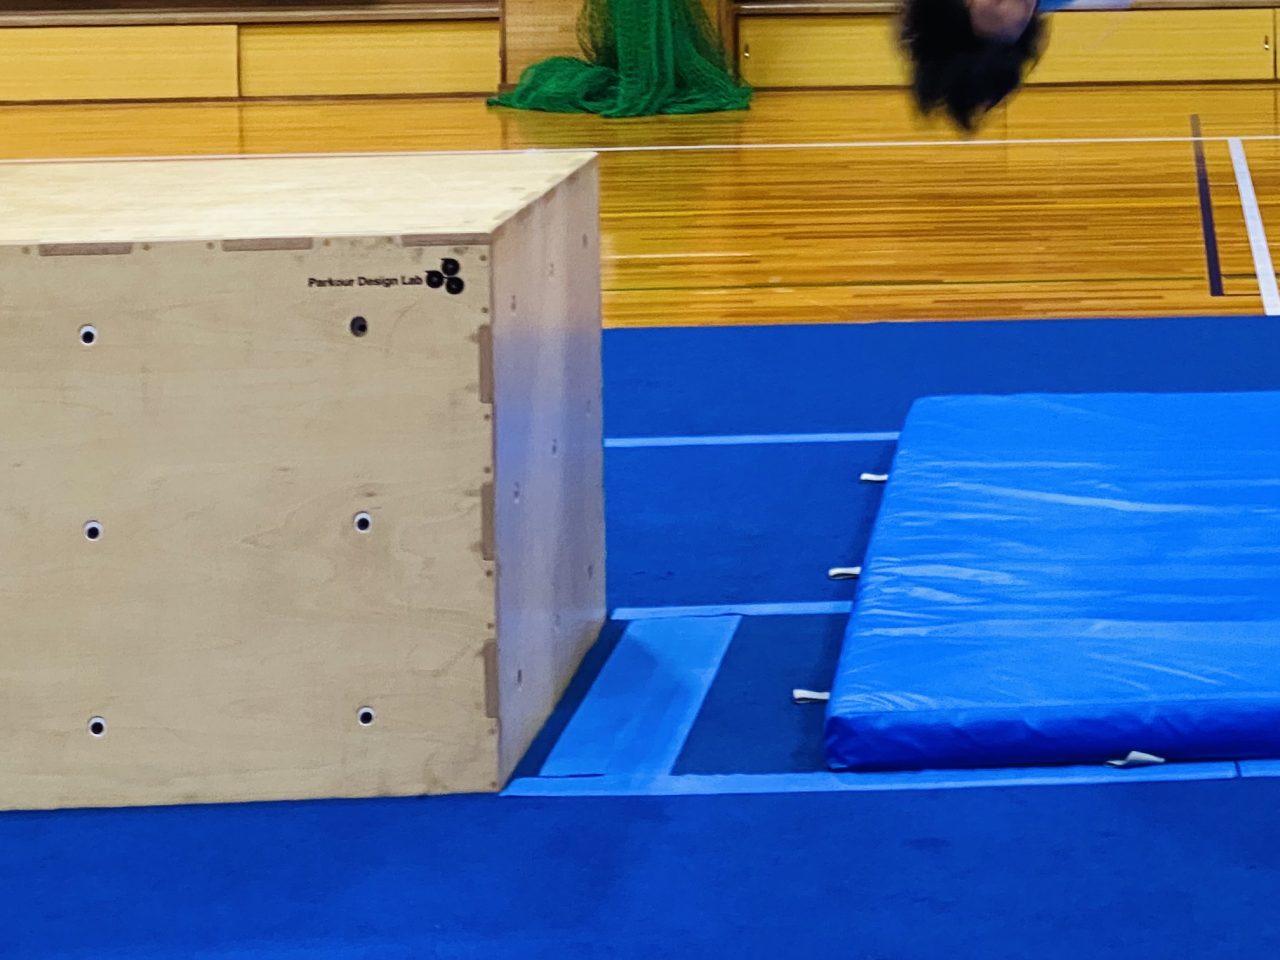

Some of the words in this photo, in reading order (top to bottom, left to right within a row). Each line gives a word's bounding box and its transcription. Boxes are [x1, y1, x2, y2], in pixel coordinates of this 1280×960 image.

[308, 277, 354, 287] Parkour
[357, 276, 398, 287] Design
[402, 275, 423, 285] Lab
